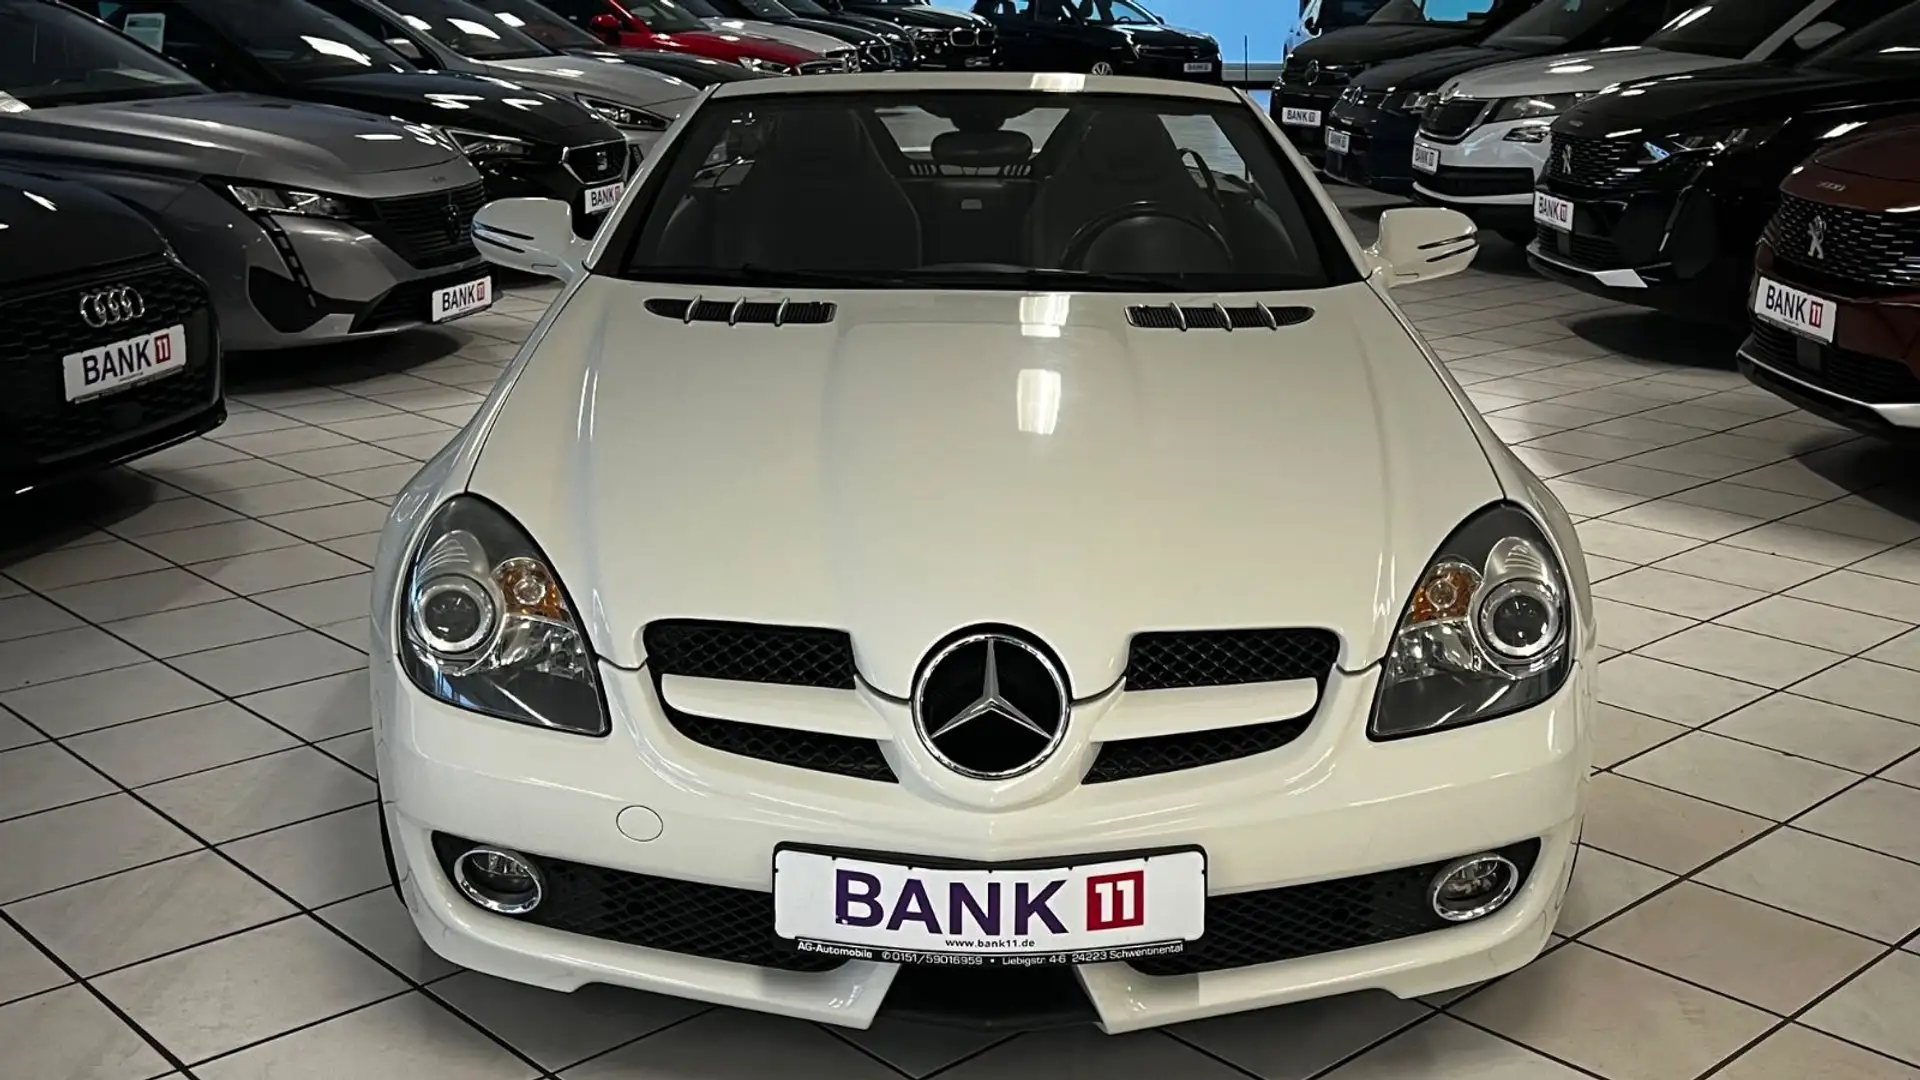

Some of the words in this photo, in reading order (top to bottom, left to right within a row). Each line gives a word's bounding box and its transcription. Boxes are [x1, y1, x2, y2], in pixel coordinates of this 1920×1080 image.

[1286, 109, 1307, 122] BANK
[591, 187, 615, 207] BANK
[1538, 195, 1560, 220] BANK
[442, 284, 475, 312] BANK
[1765, 285, 1807, 323] BANK
[1809, 302, 1822, 327] 11
[82, 339, 151, 386] BANK
[155, 335, 170, 363] 11
[835, 868, 1069, 936] BANK
[1092, 876, 1140, 926] 11
[945, 938, 1035, 949] www.bank11.de
[1072, 951, 1107, 963] 24223
